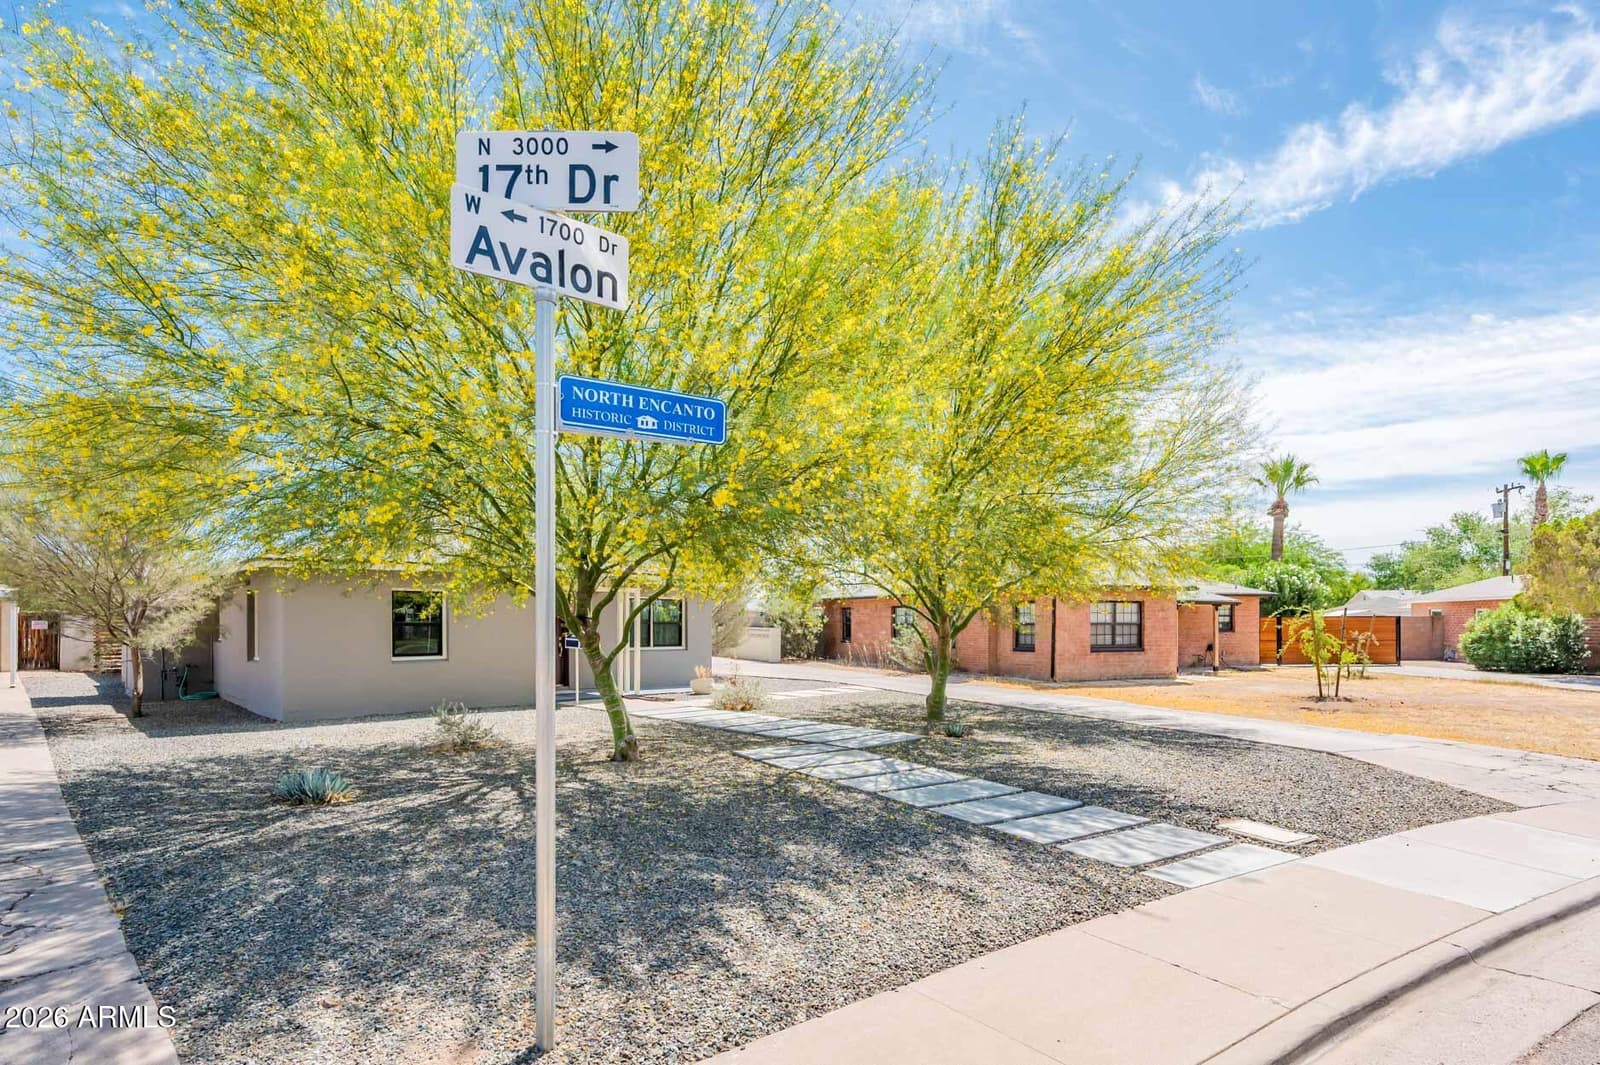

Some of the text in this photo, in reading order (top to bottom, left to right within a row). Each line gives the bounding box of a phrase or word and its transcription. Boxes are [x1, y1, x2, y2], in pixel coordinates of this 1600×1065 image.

[478, 137, 569, 156] N 3000
[478, 164, 619, 204] 17th Dr
[465, 193, 618, 256] W 1700 Dr
[465, 225, 618, 302] Avalon
[572, 386, 715, 420] NORTH ENCANTO
[572, 407, 715, 437] HISTORIC DISTRICT
